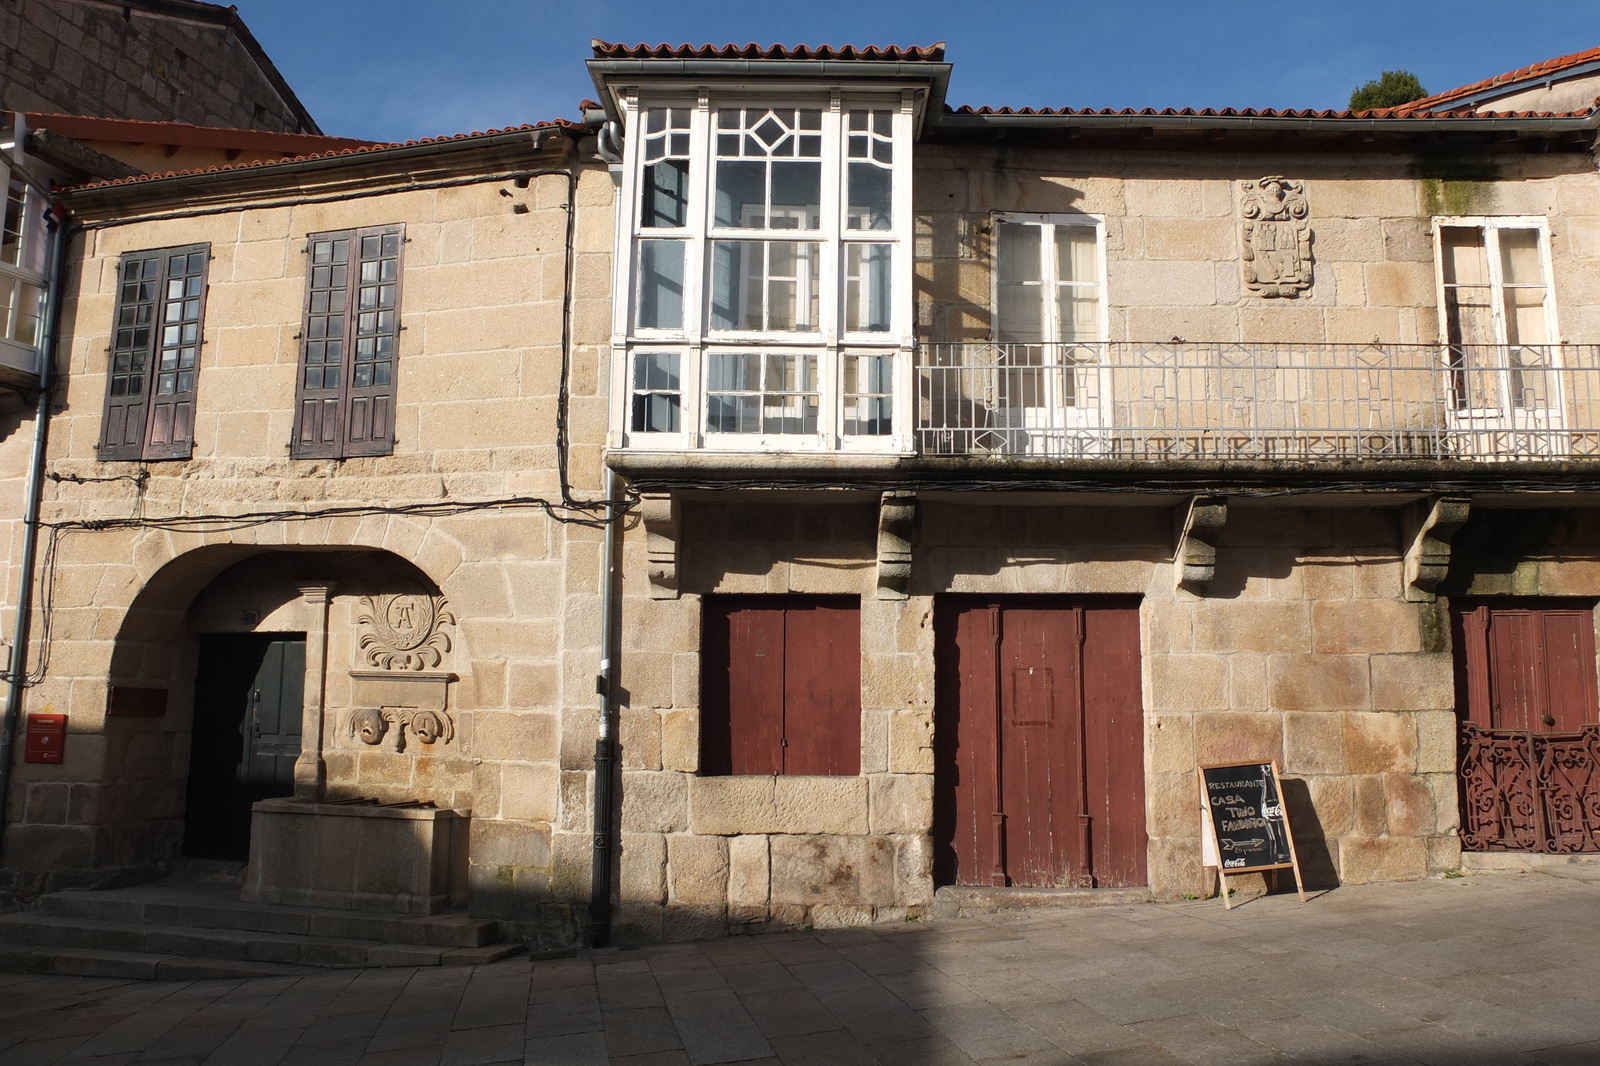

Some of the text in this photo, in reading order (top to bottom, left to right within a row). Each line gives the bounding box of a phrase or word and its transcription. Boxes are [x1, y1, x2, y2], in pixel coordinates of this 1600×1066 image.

[1208, 779, 1264, 790] RESTAURANTE
[1211, 794, 1245, 806] CASA
[1225, 806, 1255, 818] TINO
